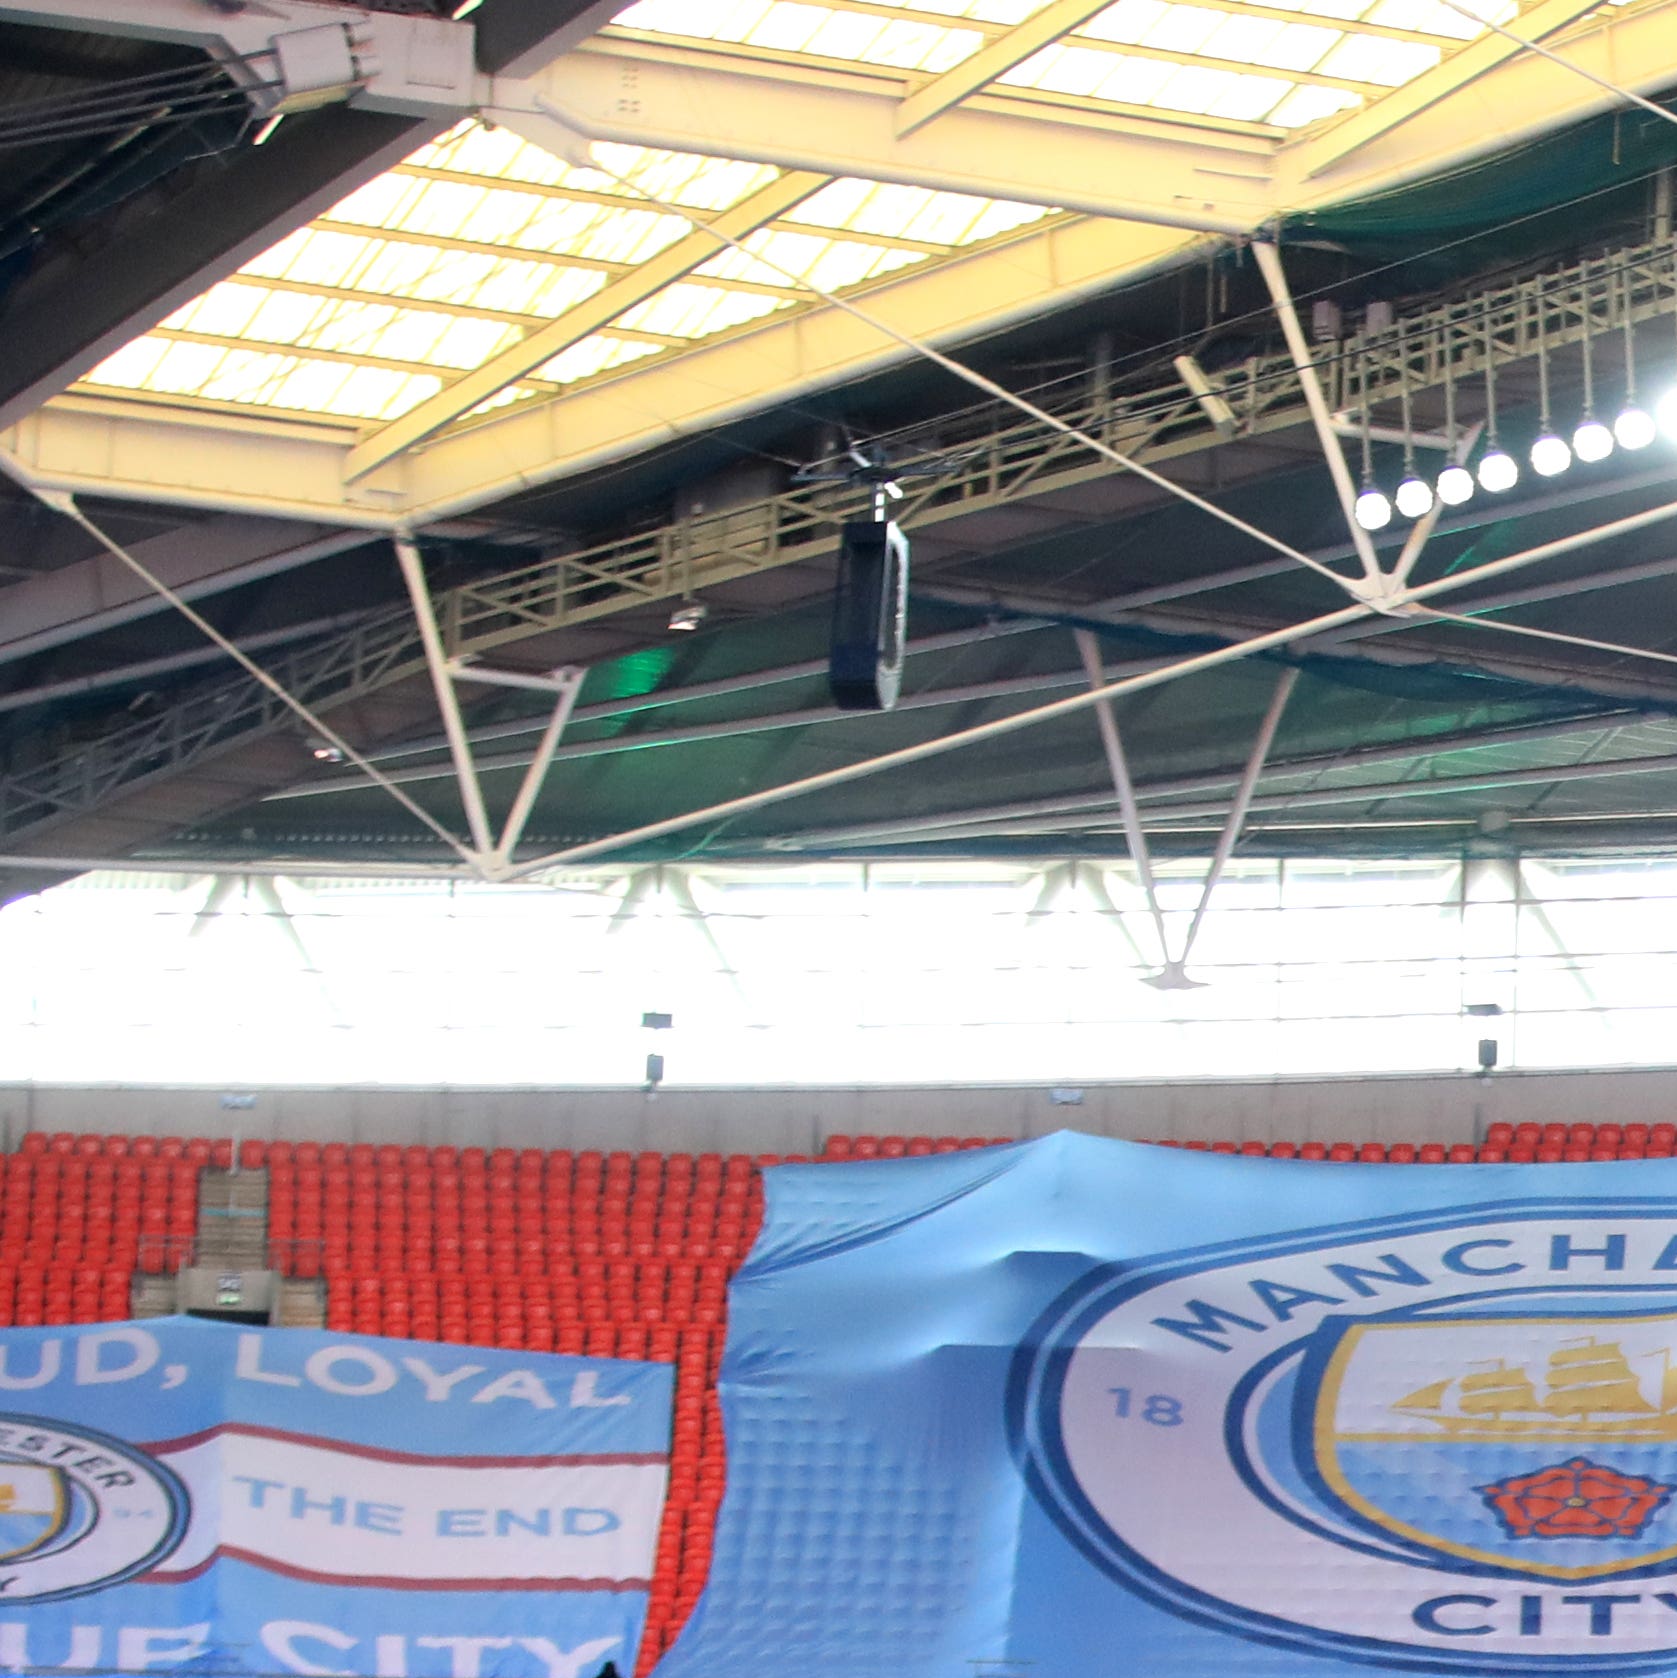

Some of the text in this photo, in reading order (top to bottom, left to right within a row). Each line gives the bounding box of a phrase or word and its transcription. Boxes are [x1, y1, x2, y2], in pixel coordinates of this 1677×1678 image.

[236, 1333, 632, 1408] LOYAL
[1107, 1386, 1184, 1428] 18
[232, 1475, 621, 1538] THE END
